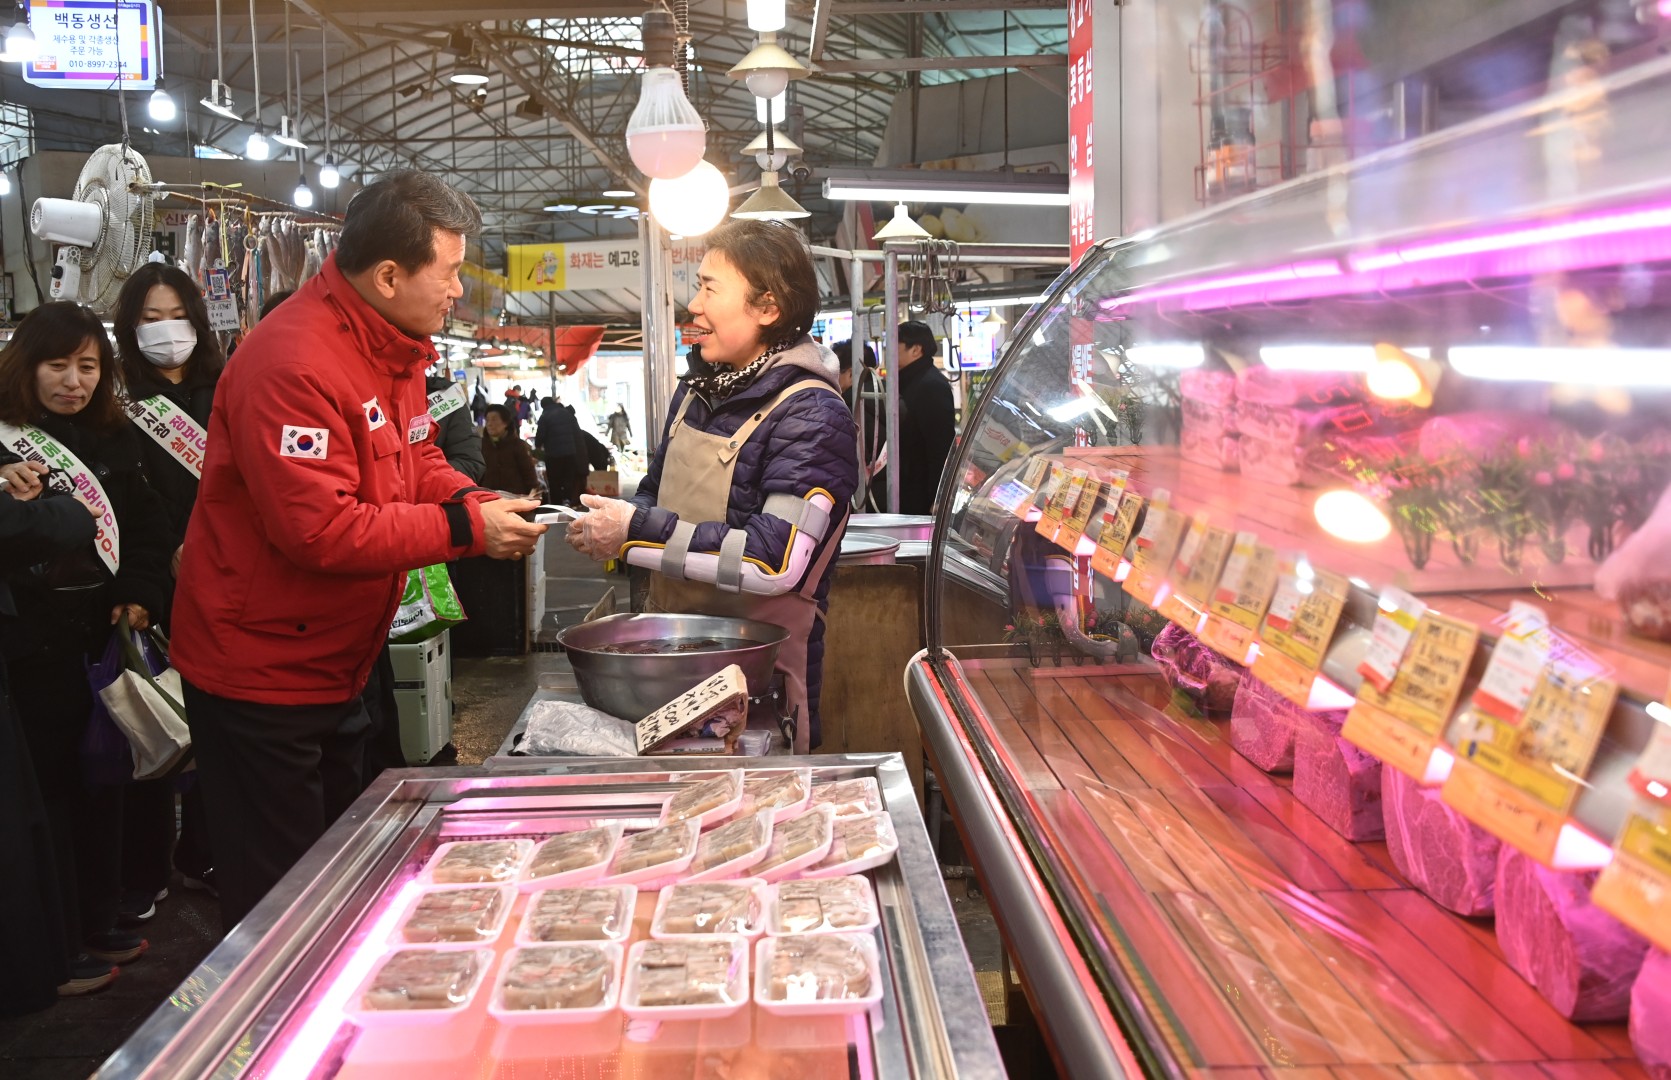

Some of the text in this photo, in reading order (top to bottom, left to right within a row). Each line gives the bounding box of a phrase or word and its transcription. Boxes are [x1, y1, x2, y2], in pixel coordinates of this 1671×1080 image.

[54, 12, 118, 30] 백동생선
[53, 34, 76, 45] 제수용
[78, 35, 86, 45] 및
[70, 46, 104, 56] 주문 가능
[570, 252, 604, 269] 화재는
